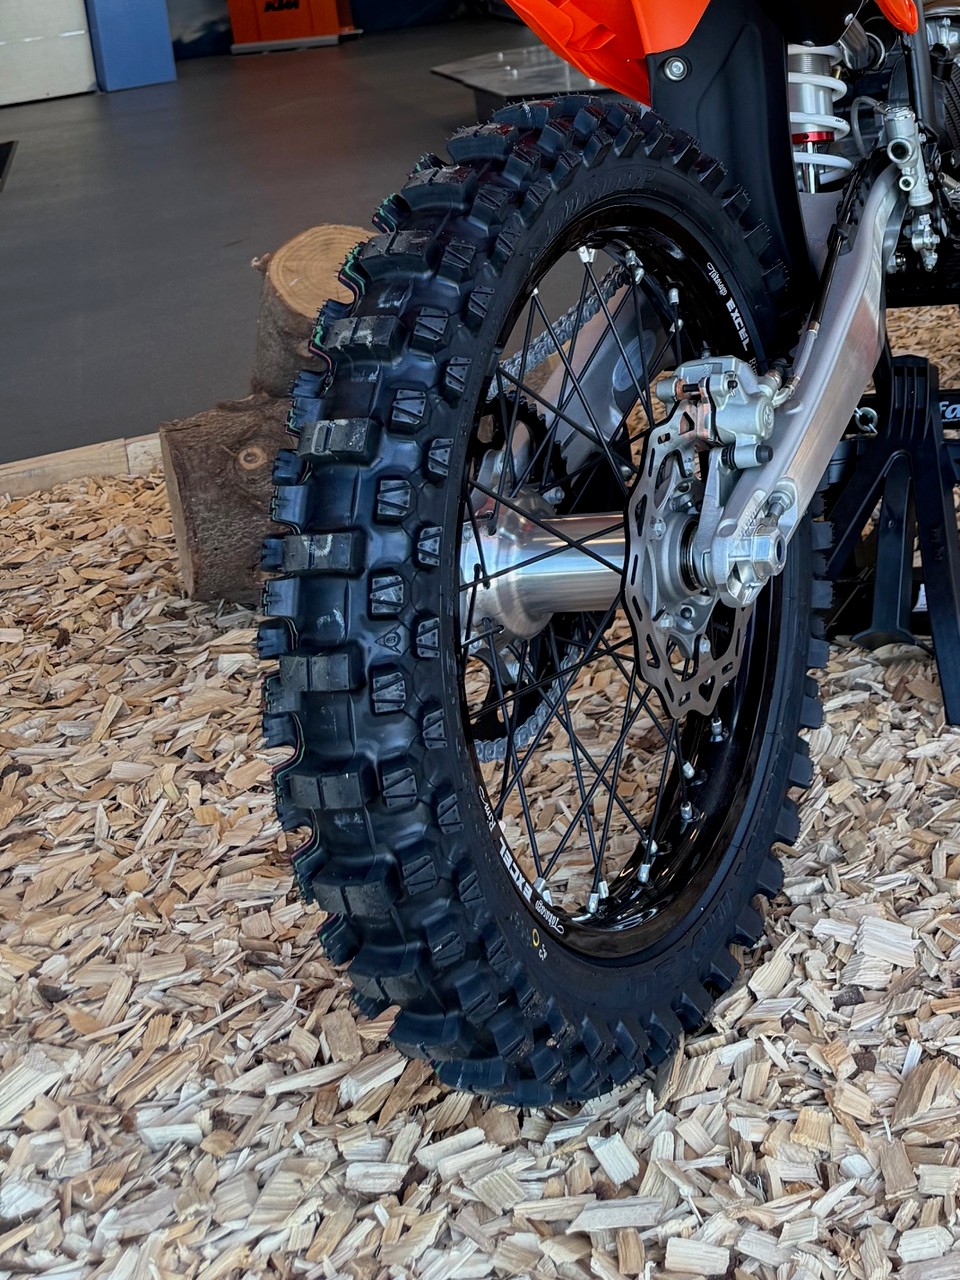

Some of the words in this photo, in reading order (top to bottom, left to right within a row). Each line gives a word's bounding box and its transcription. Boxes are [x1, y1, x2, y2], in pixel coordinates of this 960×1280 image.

[726, 297, 750, 352] EXCEL
[479, 785, 496, 833] Rim
[500, 837, 533, 903] EXCEL
